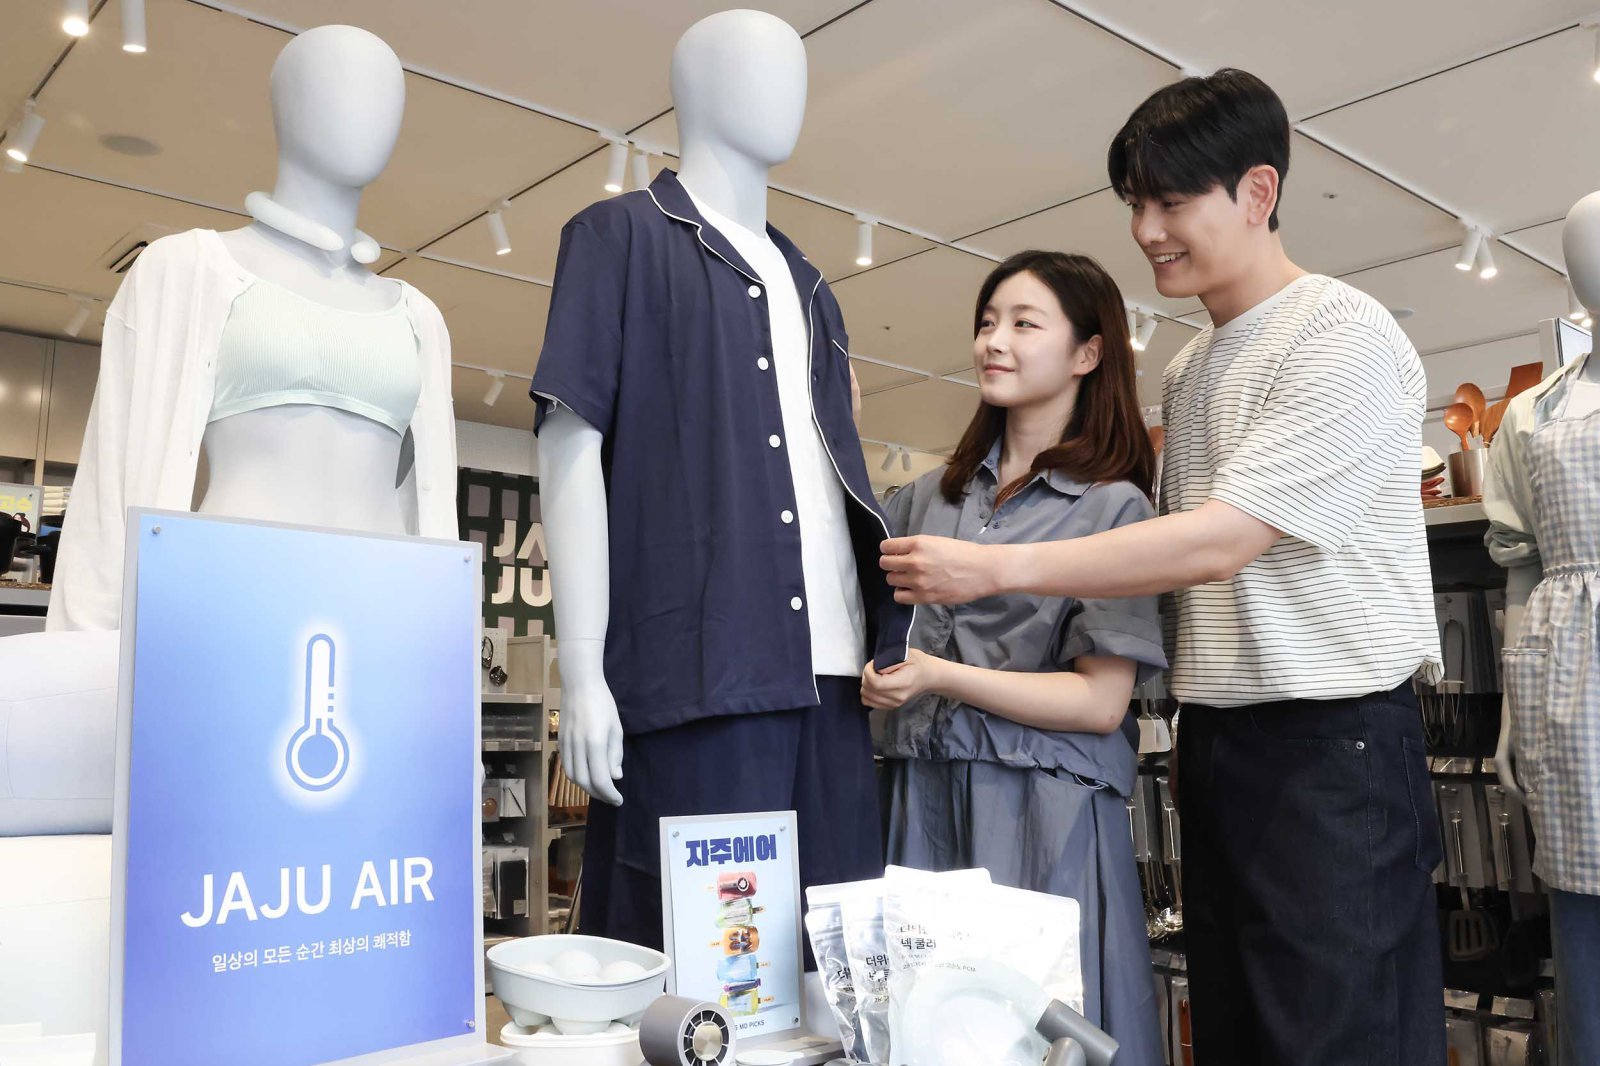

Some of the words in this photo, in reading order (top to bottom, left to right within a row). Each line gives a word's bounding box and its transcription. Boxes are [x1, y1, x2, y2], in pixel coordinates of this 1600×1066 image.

[491, 566, 553, 607] JU
[685, 834, 777, 868] 자주에어
[180, 864, 332, 928] JAJU
[350, 856, 435, 910] AIR
[211, 949, 259, 973] 일상의
[262, 945, 293, 966] 모든
[295, 941, 325, 962] 순간
[328, 935, 370, 956] 최상의
[372, 929, 412, 951] 쾌적함
[865, 953, 889, 967] 더위
